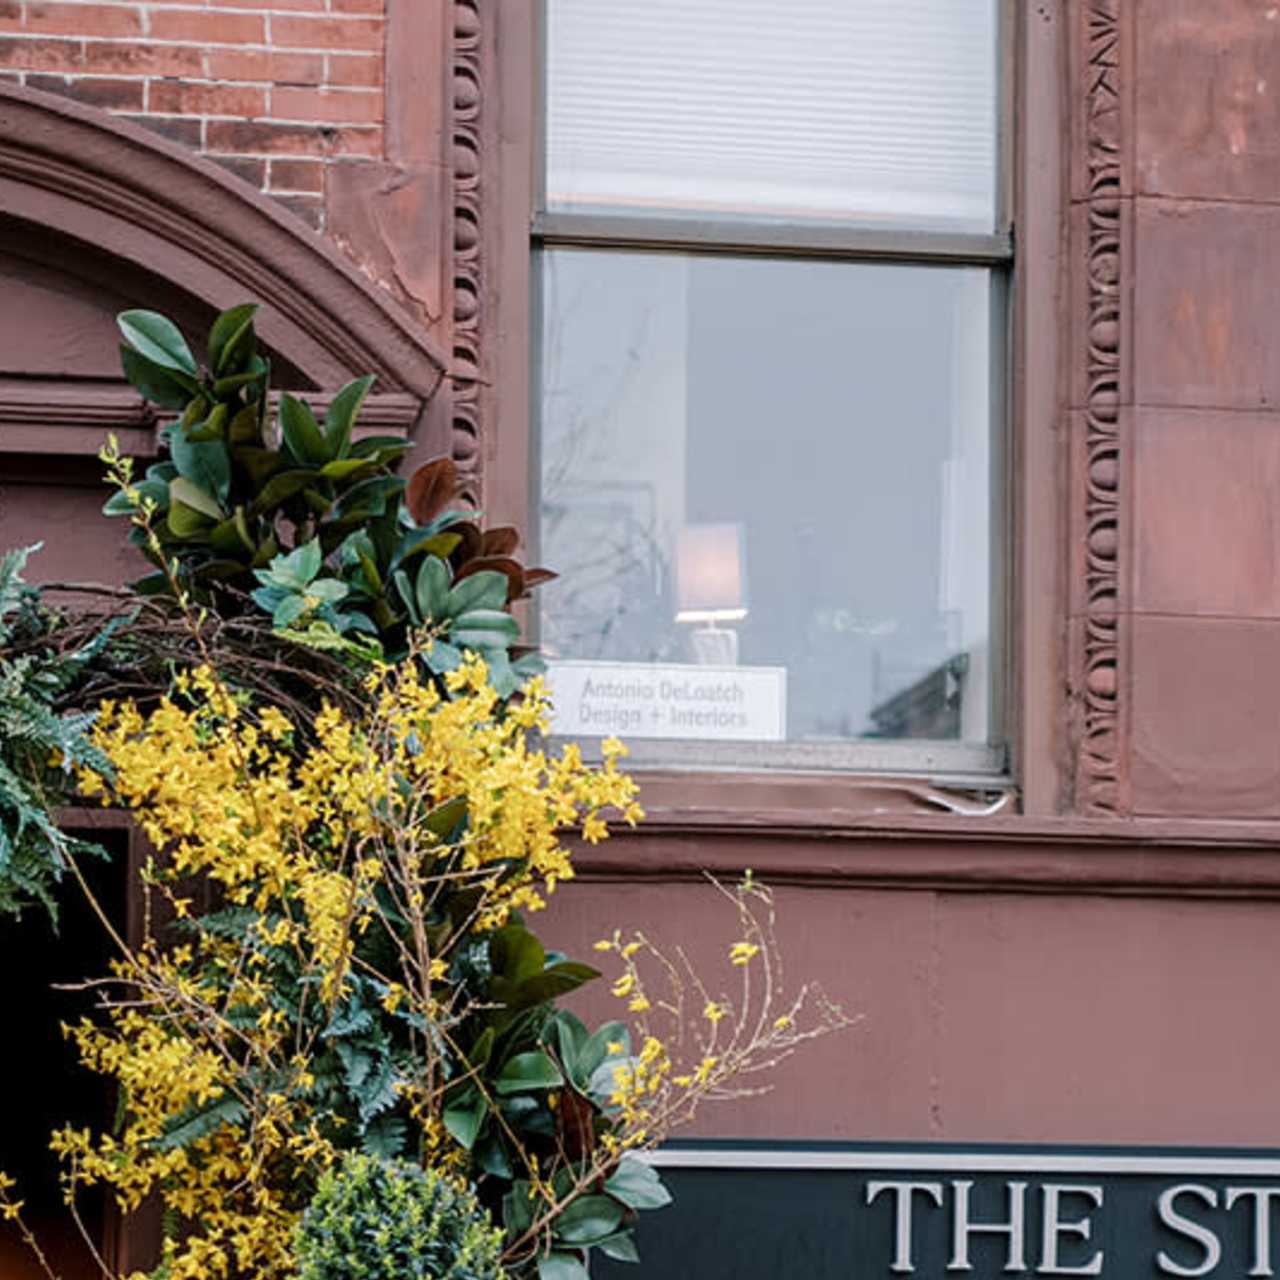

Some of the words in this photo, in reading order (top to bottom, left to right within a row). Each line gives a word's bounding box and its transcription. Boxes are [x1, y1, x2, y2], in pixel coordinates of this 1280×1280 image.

[582, 678, 655, 699] Antonio
[658, 680, 744, 702] DeLoatch
[579, 703, 641, 729] Design
[670, 706, 748, 728] Interiors
[866, 1180, 1104, 1275] THE
